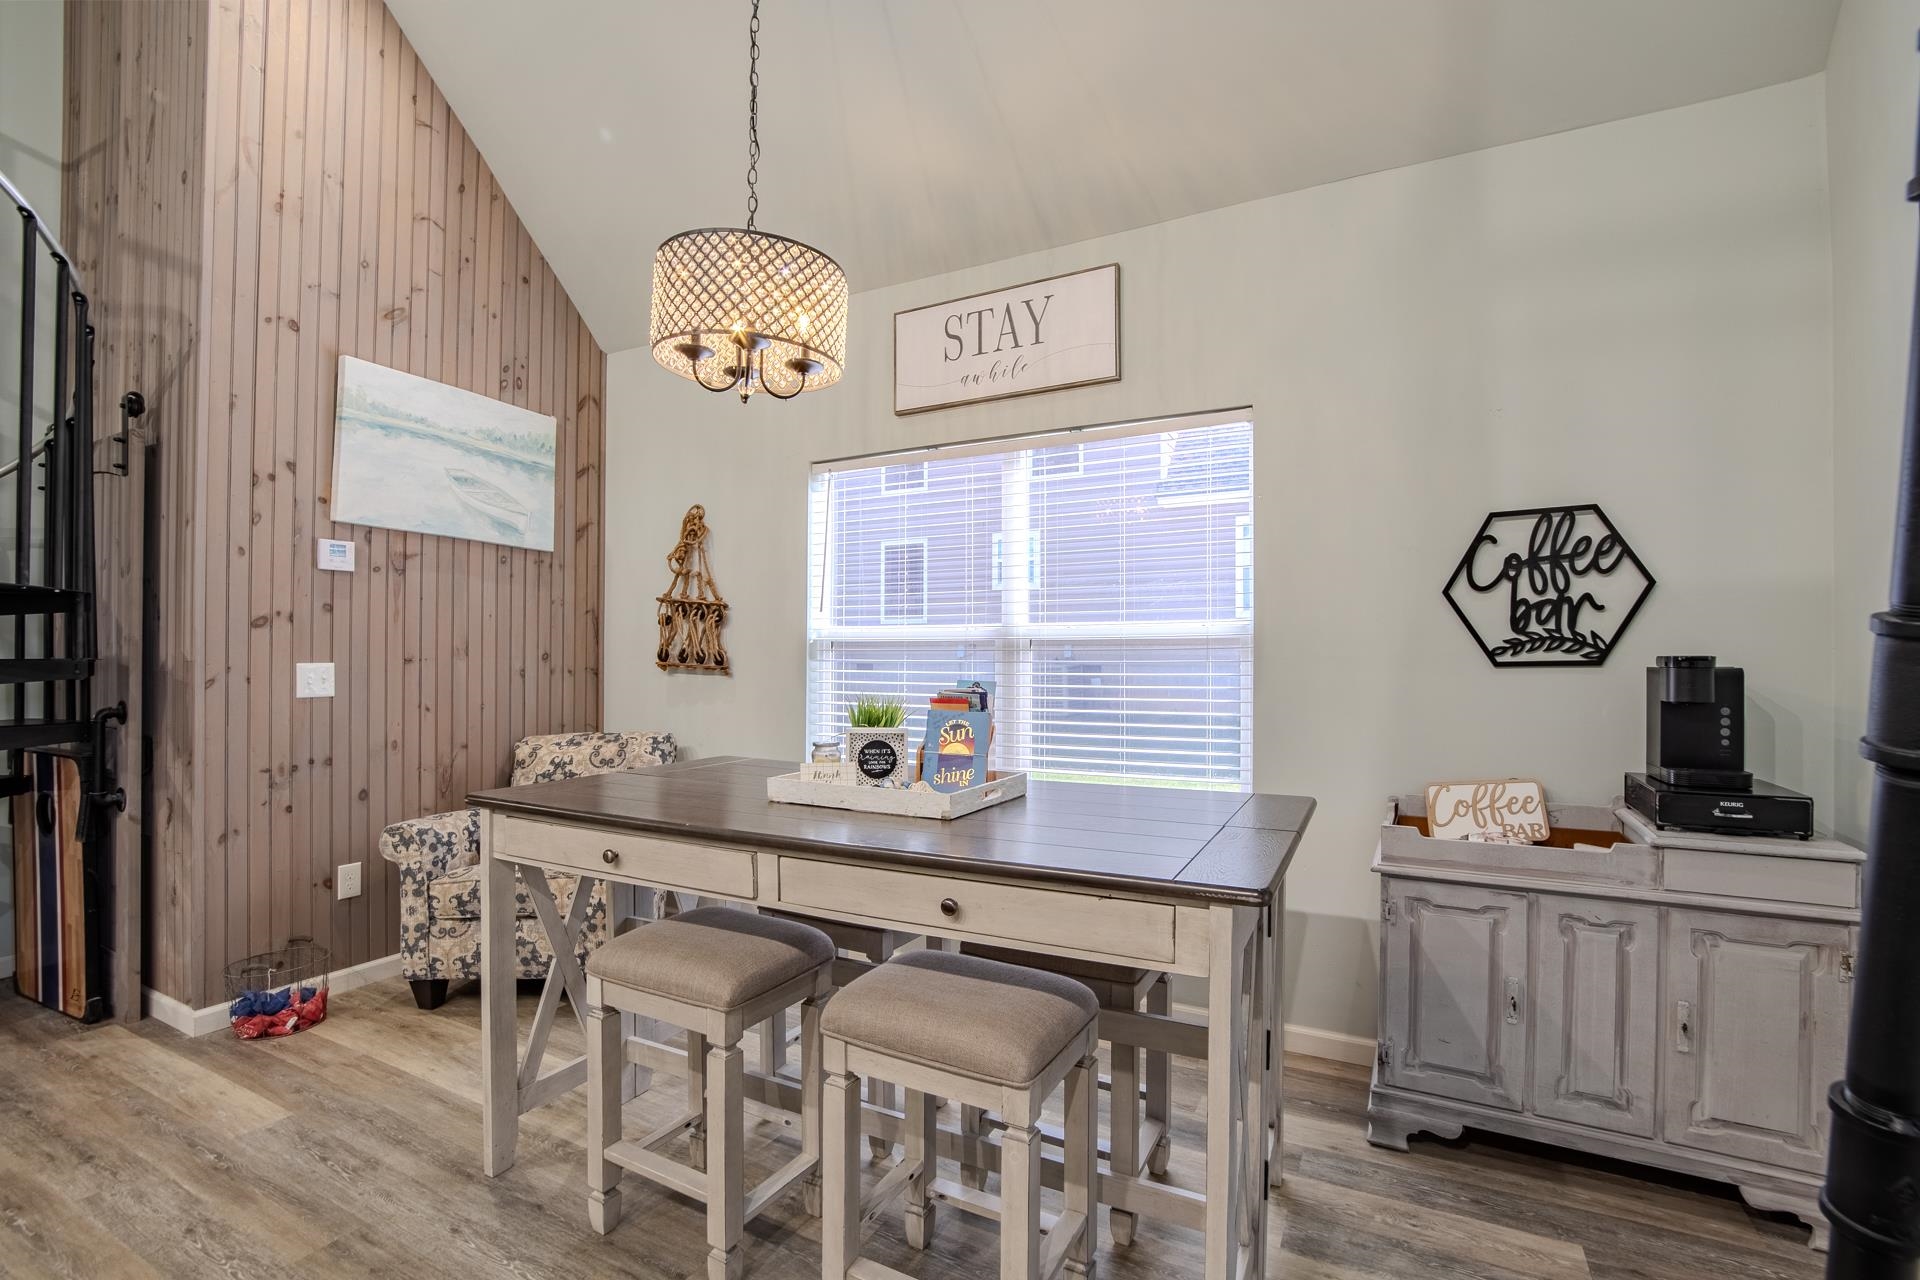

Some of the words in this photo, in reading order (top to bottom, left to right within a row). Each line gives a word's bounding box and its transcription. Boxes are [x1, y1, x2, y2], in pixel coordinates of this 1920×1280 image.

[944, 294, 1055, 362] STAY
[960, 354, 1029, 387] awhile
[1466, 510, 1627, 595] Coffee
[1510, 583, 1605, 635] bar
[939, 726, 975, 744] Sun
[945, 719, 957, 727] LET
[958, 719, 970, 728] THE
[933, 767, 975, 785] shine
[1431, 783, 1541, 828] Coffee
[1503, 822, 1545, 840] BAR
